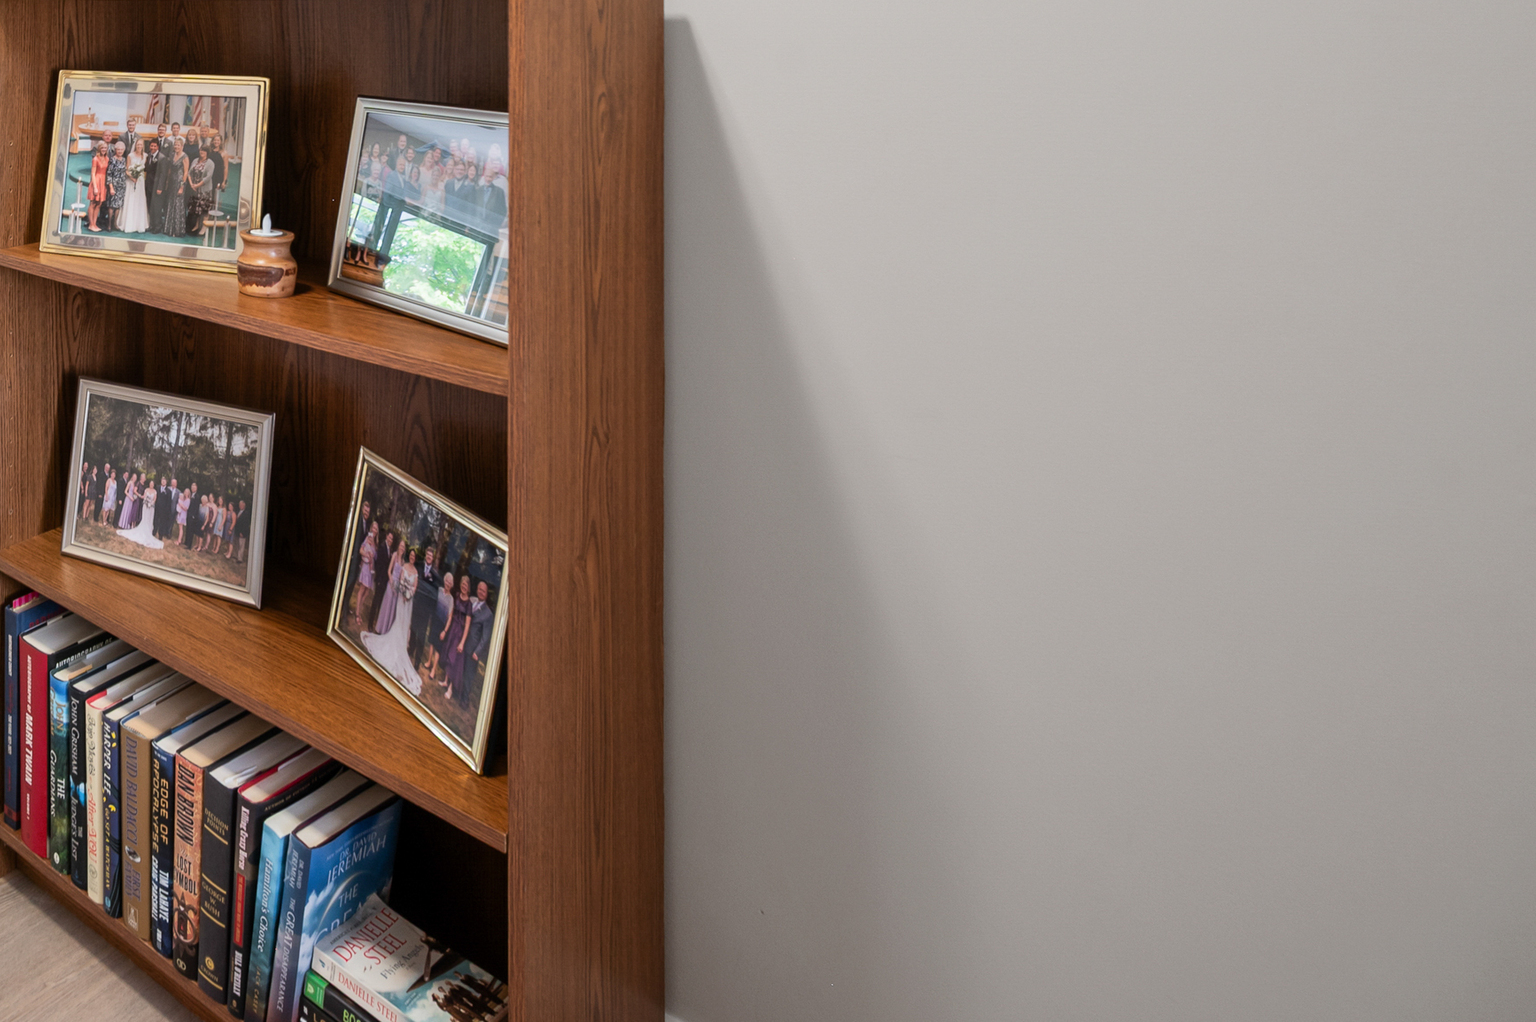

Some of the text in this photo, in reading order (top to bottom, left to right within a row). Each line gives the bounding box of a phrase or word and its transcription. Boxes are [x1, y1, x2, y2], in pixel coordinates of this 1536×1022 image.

[27, 704, 32, 714] OF
[55, 700, 67, 732] JOHN
[25, 712, 34, 748] MARK
[70, 696, 80, 775] JOHN GRISHAM
[25, 747, 34, 786] TWAIN
[50, 749, 58, 818] GUARDIANS
[57, 778, 66, 800] THE
[104, 772, 112, 796] LEE
[126, 736, 138, 846] DAVID BALDACCI
[87, 788, 98, 827] After
[152, 759, 160, 853] APOCALYPSE
[160, 779, 168, 845] EDGE OF
[176, 763, 195, 846] DAN BROWN
[204, 808, 229, 832] DECISION
[239, 806, 249, 832] Killing
[71, 795, 79, 862] JUDGE'S LIST
[207, 817, 225, 836] POINTS
[239, 829, 248, 851] Crazy
[352, 831, 378, 852] DAVID
[176, 853, 191, 876] LOST
[238, 849, 247, 871] Horse
[289, 848, 299, 889] JEREMIAH
[327, 834, 387, 885] JEREMIAH
[124, 859, 133, 900] FAMILY
[132, 868, 141, 902] FIRST
[159, 869, 169, 888] TIM
[202, 881, 225, 904] GEORGE
[338, 883, 359, 907] THE
[204, 900, 220, 918] BUSH
[257, 858, 274, 953] Hamilton's Choice
[284, 910, 297, 948] GREAT
[332, 907, 399, 963] DANIELLE
[235, 950, 243, 967] BILL
[363, 933, 407, 966] STEEL
[233, 965, 242, 997] O'REILLY
[277, 946, 291, 1013] DISAPPEARANCE
[380, 959, 405, 979] Flying
[338, 972, 375, 1008] DANIELLE
